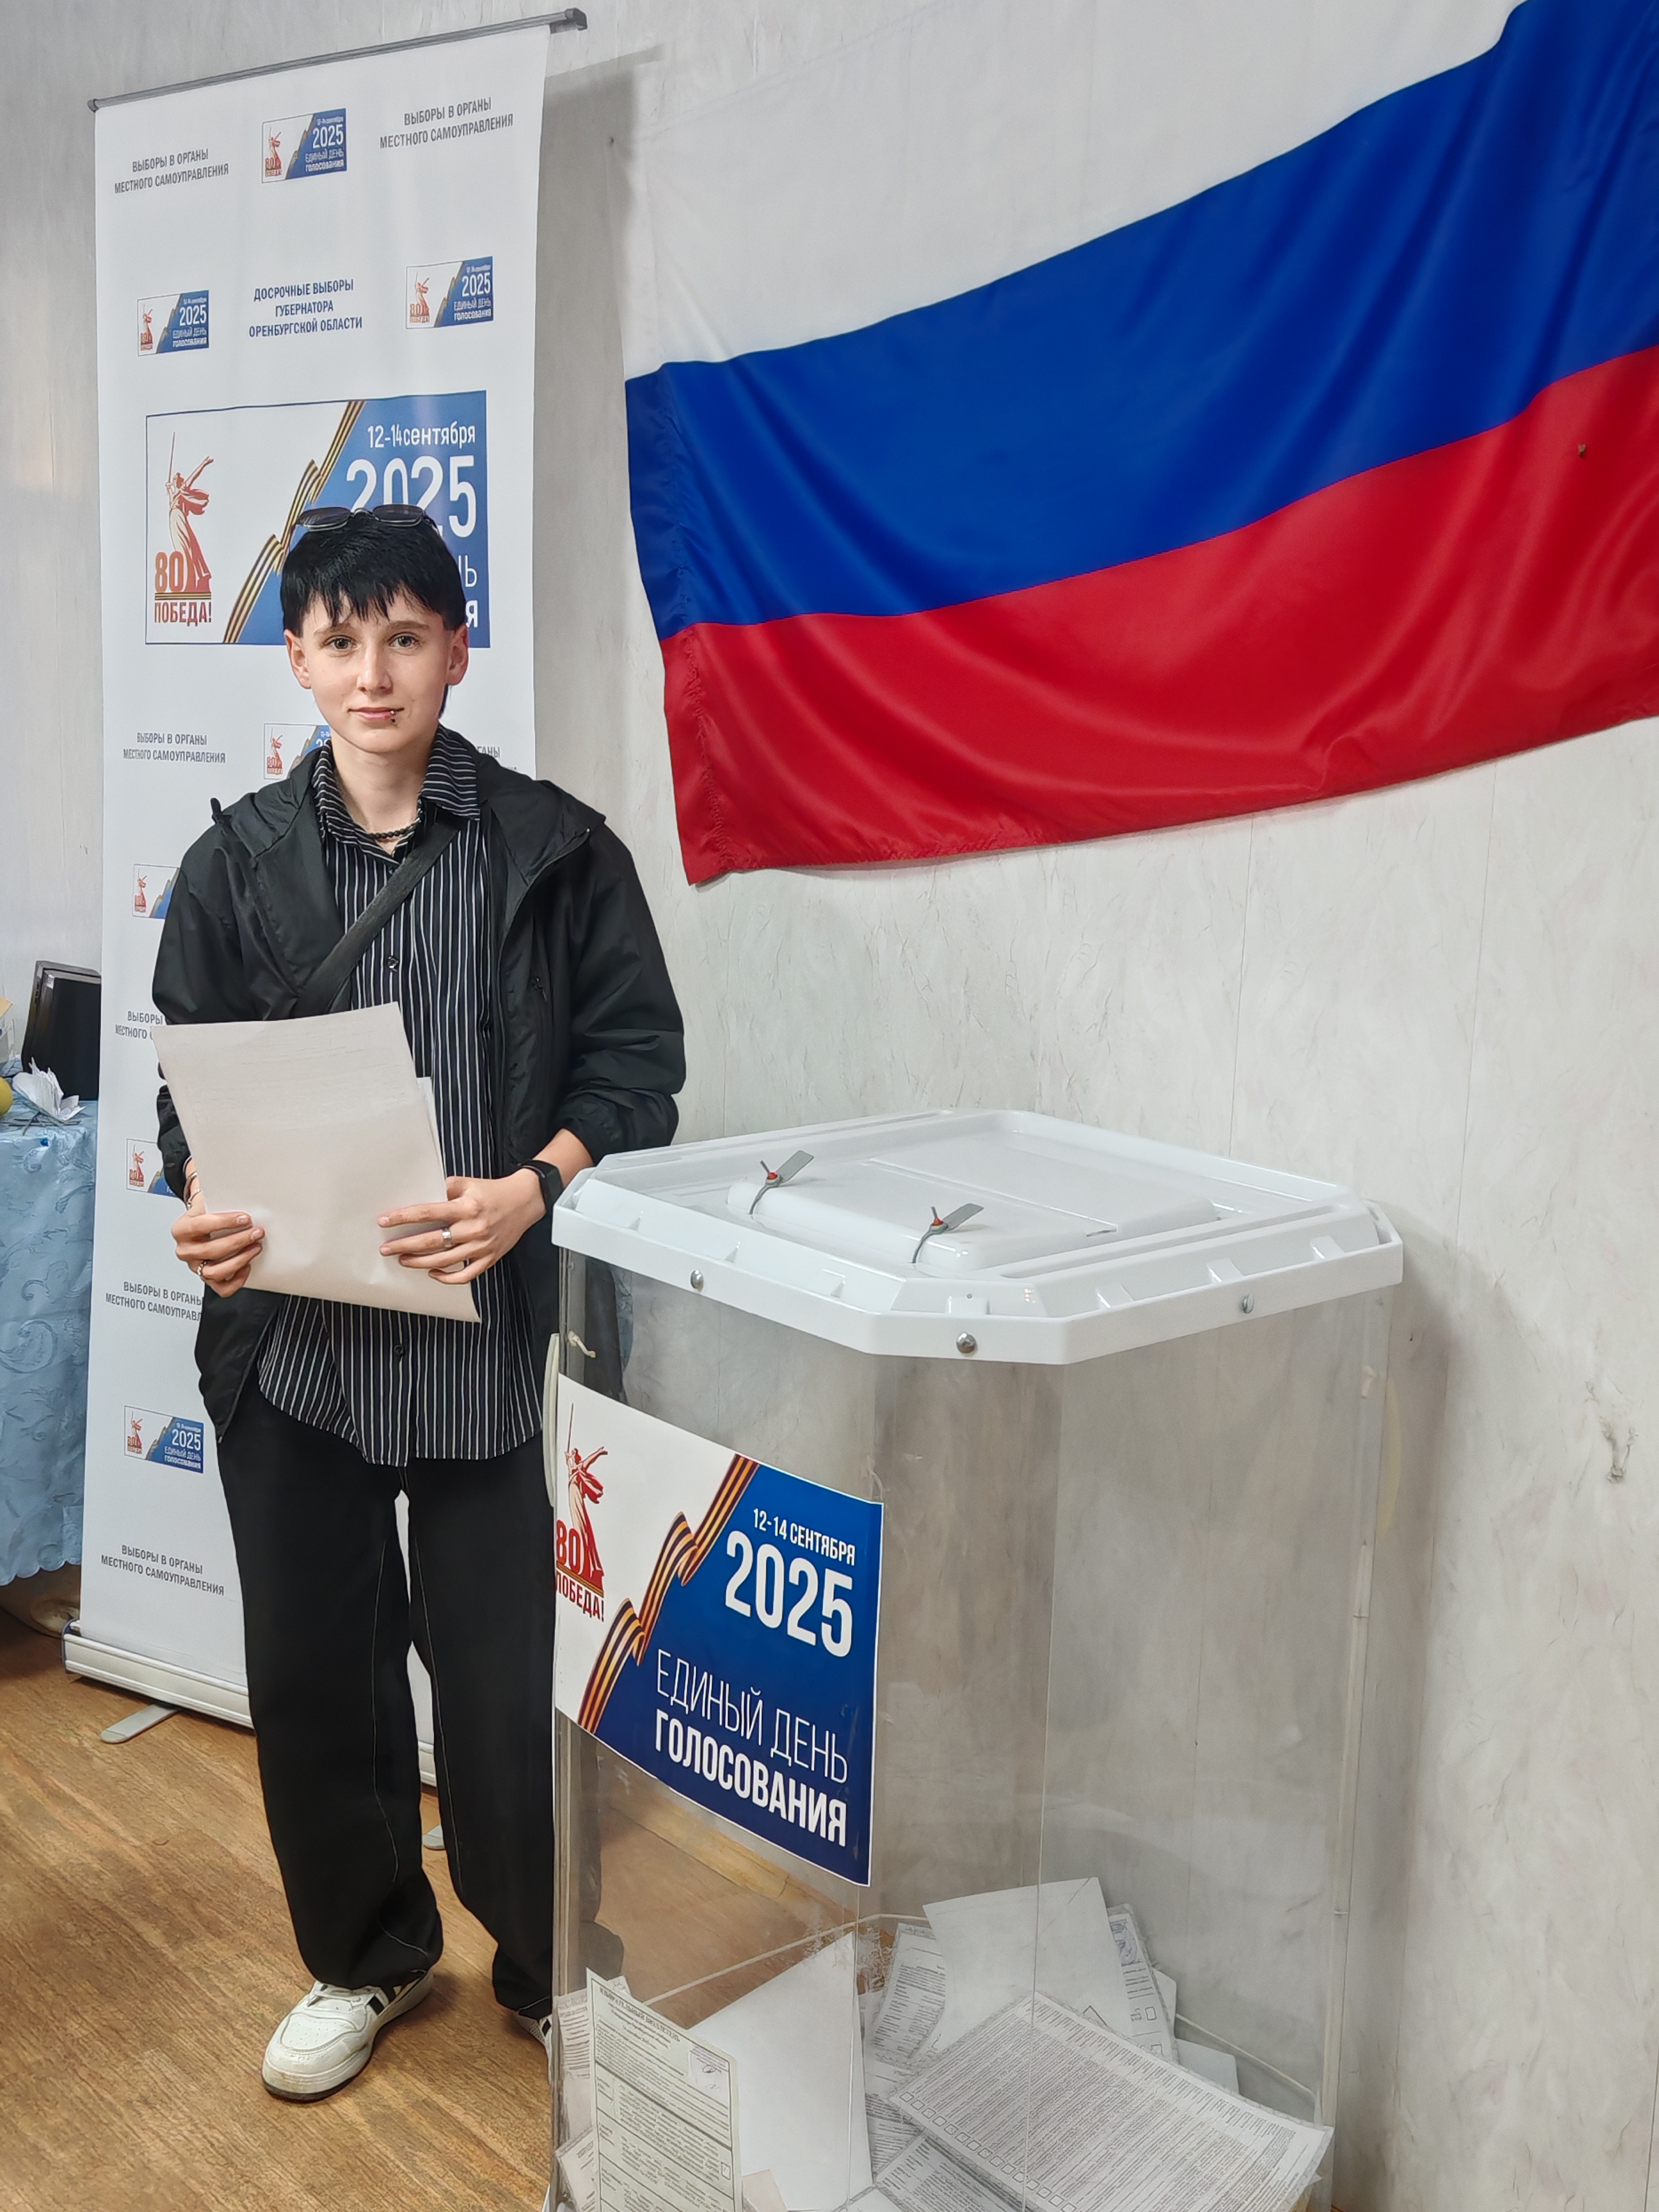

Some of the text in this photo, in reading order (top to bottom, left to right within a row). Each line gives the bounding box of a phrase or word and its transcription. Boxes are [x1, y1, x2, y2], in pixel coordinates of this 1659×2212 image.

[404, 97, 491, 125] ВЫБОРЫ В ОРГАНЫ
[313, 124, 343, 149] 2025
[380, 113, 513, 149] МЕСТНОГО САМОУПРАВЛЕНИЯ
[132, 148, 208, 172] ВЫБОРЫ В ОРГАНЫ
[114, 163, 229, 194] МЕСТНОГО САМОУПРАВЛЕНИЯ
[253, 279, 354, 302] ДОСРОЧНЫЕ ВЫБОРЫ
[462, 272, 491, 297] 2025
[179, 304, 207, 326] 2025
[275, 300, 334, 317] ГУБЕРНАТОРА
[249, 316, 362, 337] ОРЕНБУРГСКОЙ ОБЛАСТИ
[155, 551, 184, 593] 80
[154, 602, 212, 627] ПОБЕДА!
[137, 732, 207, 745] ВЫБОРЫ В ОРГАНЫ
[153, 750, 226, 764] САМОУПРАВЛЕНИЯ
[127, 1011, 163, 1025] ВЫБОРЫ
[124, 1282, 161, 1298] ВЫБОРЫ
[163, 1289, 168, 1299] В
[106, 1293, 201, 1321] МЕСТНОГО САМОУПРАВЛ
[172, 1429, 201, 1451] 2025
[556, 1520, 581, 1575] 80
[753, 1508, 855, 1566] 12-14 СЕНТЯБРЯ
[122, 1545, 203, 1574] ВЫБОРЫ В ОРГАНЫ
[101, 1555, 224, 1596] МЕСТНОГО САМОУПРАВЛЕНИЯ
[556, 1571, 604, 1623] ПОБЕДА!
[725, 1530, 853, 1657] 2025
[657, 1649, 848, 1783] ЕДИНЫЙ ДЕНЬ
[655, 1709, 847, 1847] ГОЛОСОВАНИЯ
